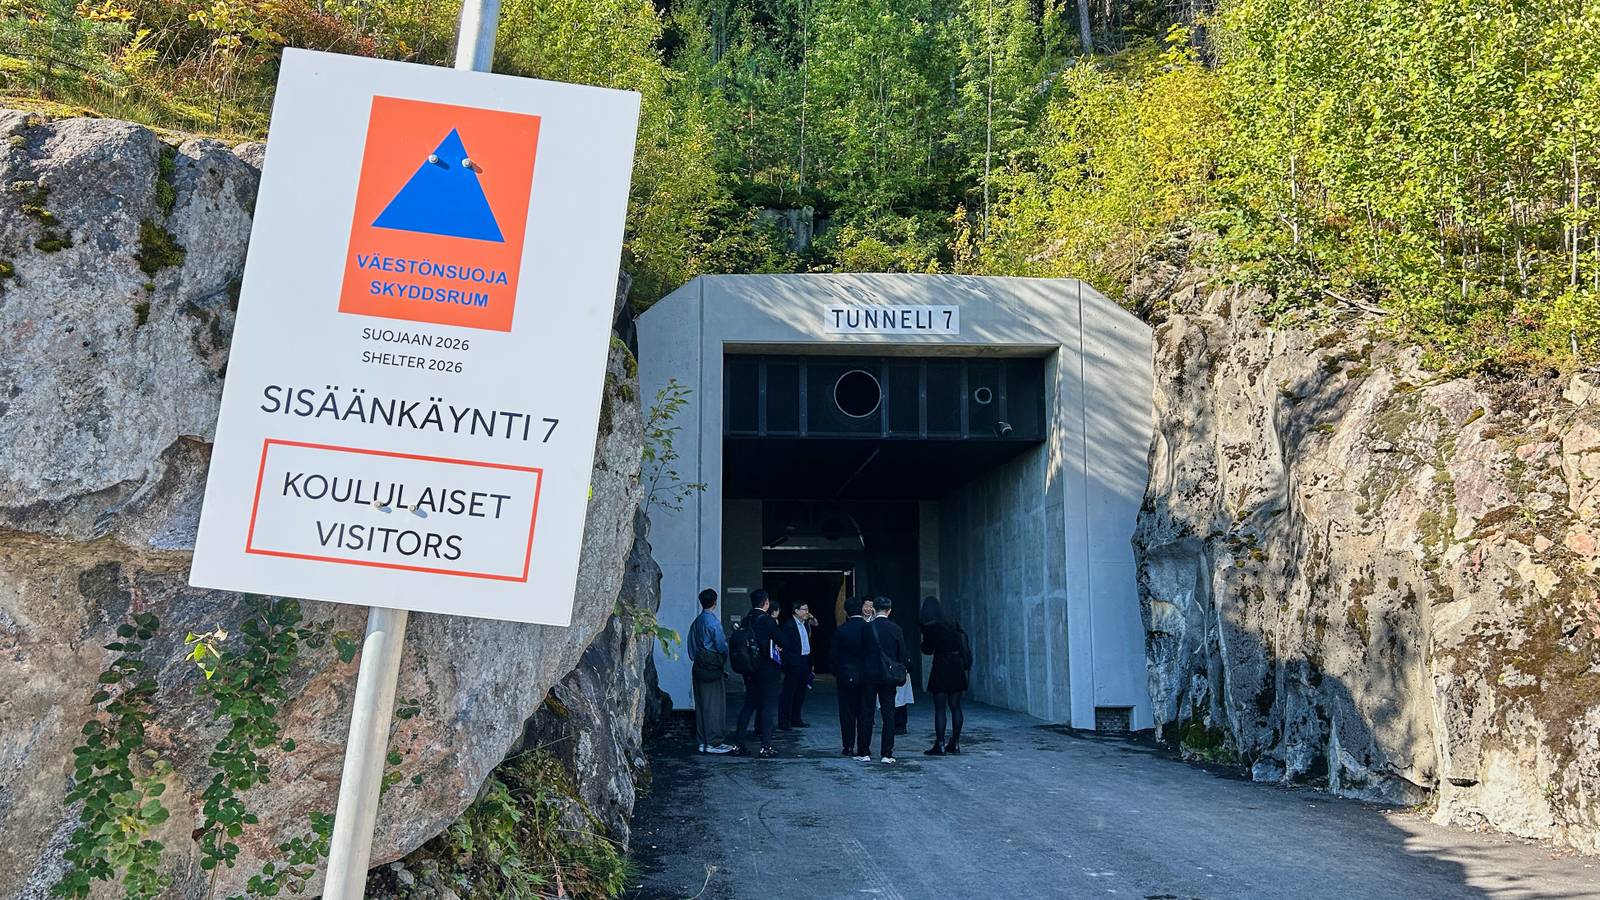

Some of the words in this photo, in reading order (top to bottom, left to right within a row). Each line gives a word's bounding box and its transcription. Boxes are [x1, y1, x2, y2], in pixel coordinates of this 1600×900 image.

[357, 254, 509, 286] VÄESTÖNSUOJA
[370, 280, 489, 308] SKYDDSRUM
[831, 309, 932, 329] TUNNELI
[942, 310, 953, 329] 7
[362, 327, 433, 347] SUOJAAN
[435, 336, 471, 351] 2026
[362, 350, 425, 369] SHELTER
[428, 359, 463, 374] 2026
[260, 385, 531, 441] SISÄÄNKÄYNTI
[542, 417, 560, 443] 7
[282, 471, 511, 519] KOULULAISET
[316, 520, 463, 561] VISITORS
